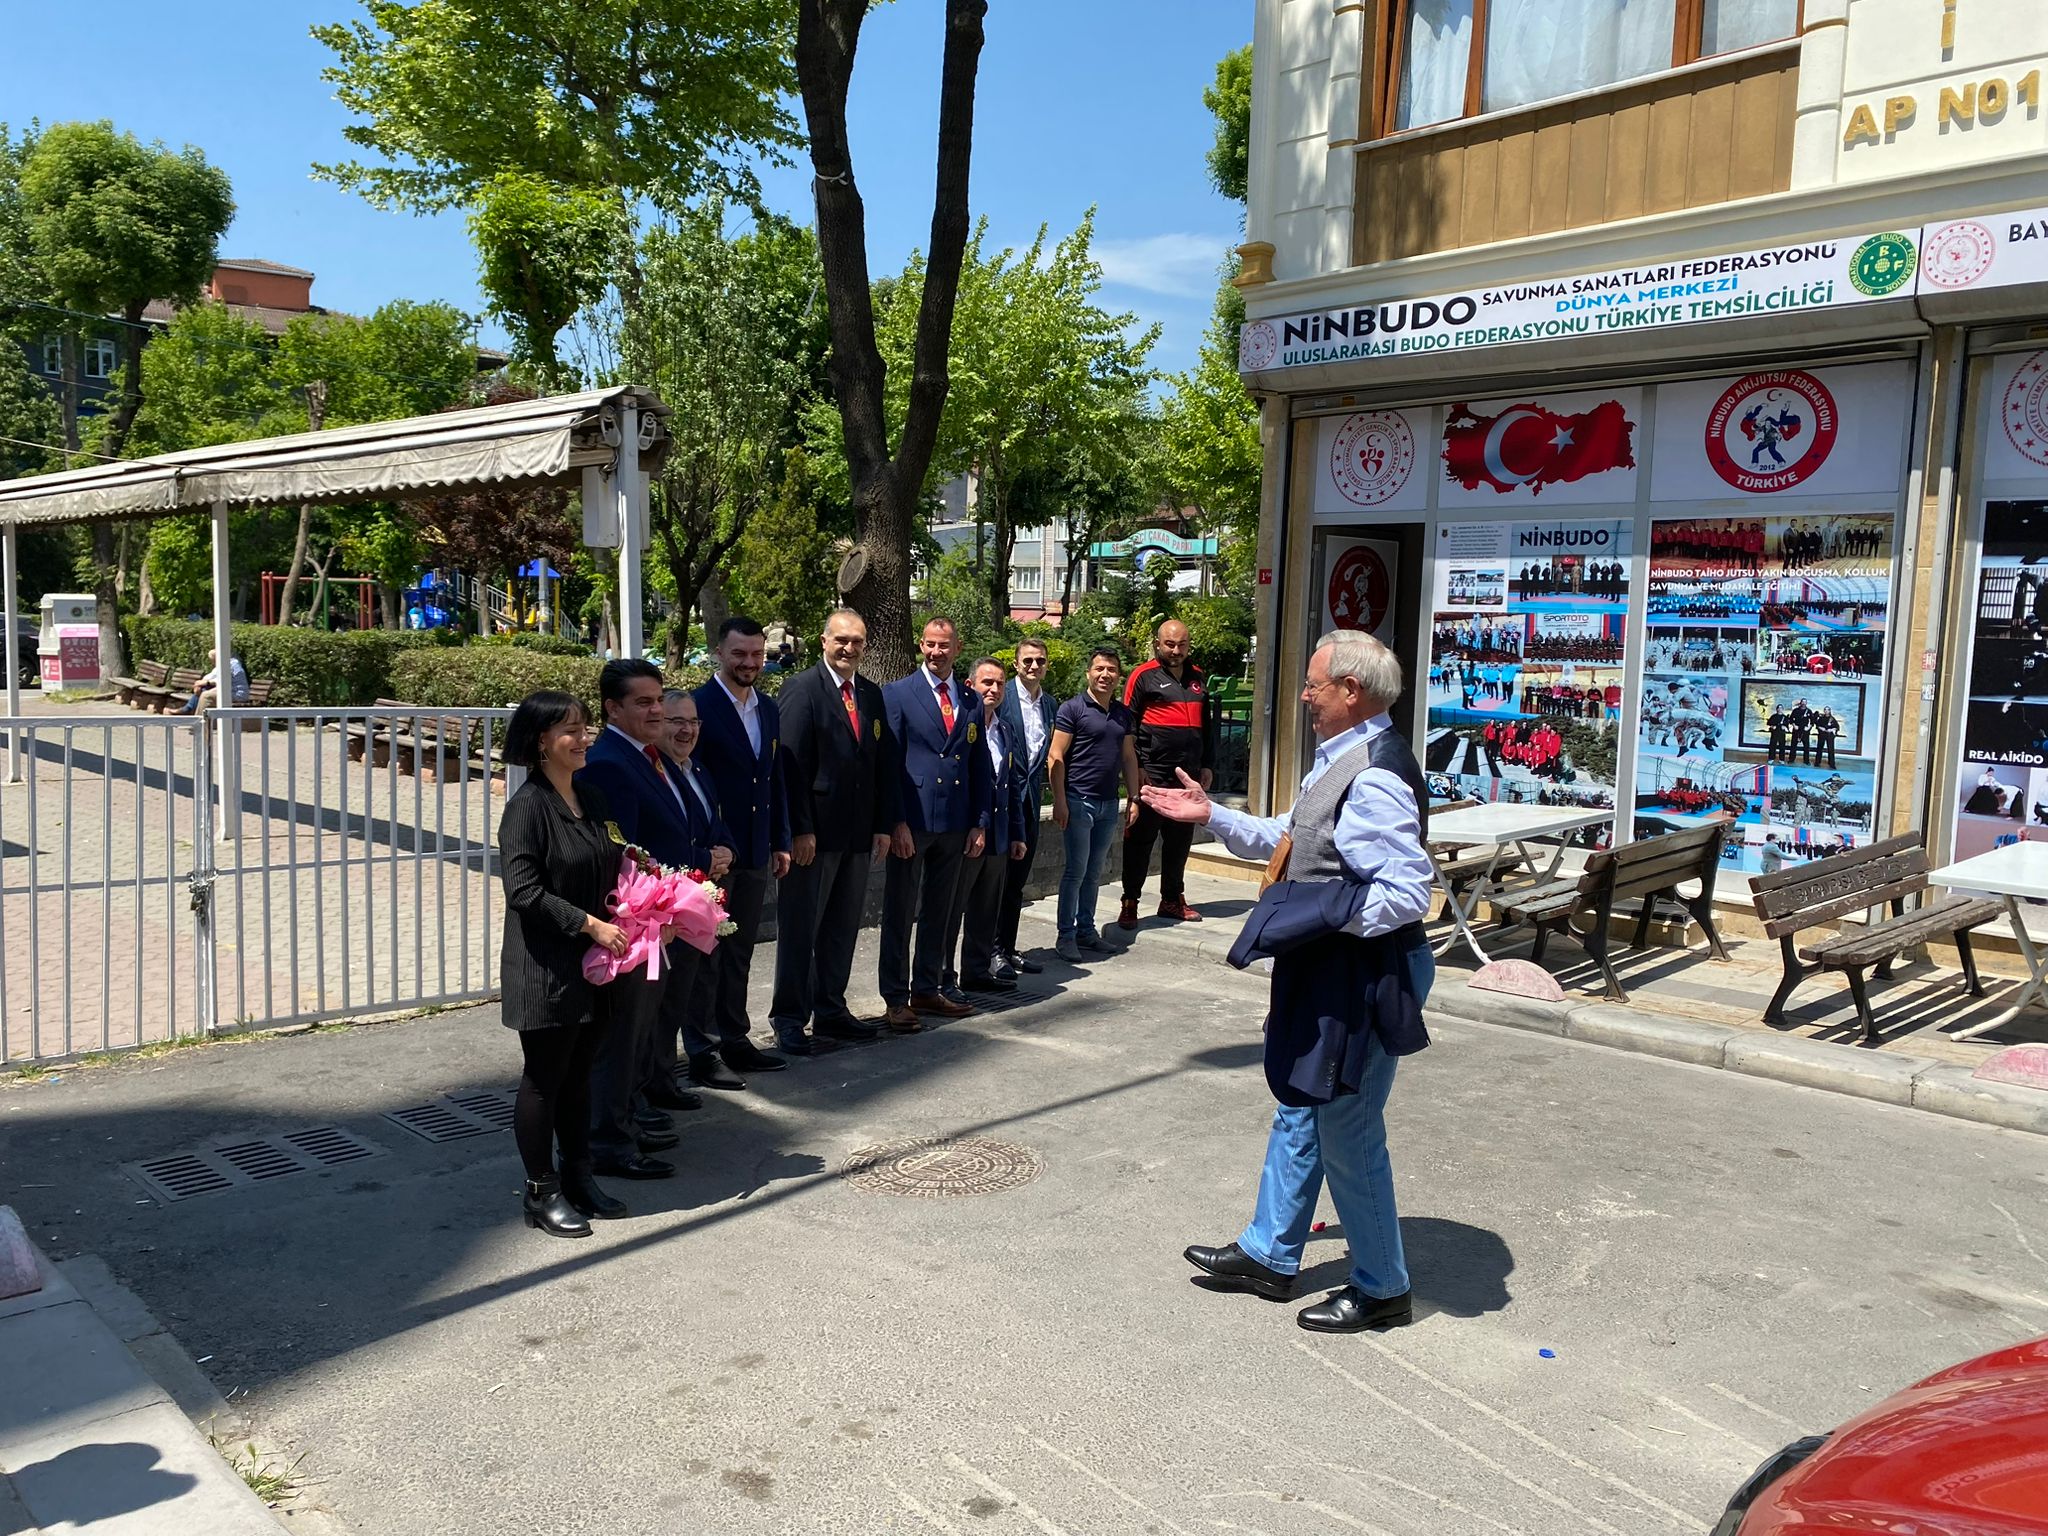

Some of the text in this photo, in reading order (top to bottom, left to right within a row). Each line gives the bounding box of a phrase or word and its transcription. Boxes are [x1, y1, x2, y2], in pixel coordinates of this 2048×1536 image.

[1844, 95, 1917, 144] AP
[1880, 234, 1904, 243] BUDO
[1482, 243, 1837, 306] SAVUNMA SANATLARI FEDERASYONU
[1850, 244, 1873, 294] INTERNATIONAL
[1885, 247, 1916, 292] FEDERATION
[1556, 273, 1739, 313] DÜNYA MERKEZİ
[1283, 340, 1395, 366] ULUSLARARASI
[1401, 333, 1450, 353] BUDO
[1455, 316, 1590, 346] FEDERASYONU
[1595, 303, 1682, 330] TÜRKİYE
[1688, 279, 1834, 318] TEMSİLCİLİĞİ
[1789, 374, 1832, 431] FEDERASYONU
[1737, 471, 1798, 488] TÜRKİYE
[1650, 582, 1694, 591] SAVUNMA
[1697, 583, 1709, 591] VE
[1726, 568, 1754, 577] JUTSU
[1757, 568, 1787, 577] YAKIN
[1844, 568, 1887, 577] KOLLUK
[1969, 750, 2044, 764] REAL AİKİDO
